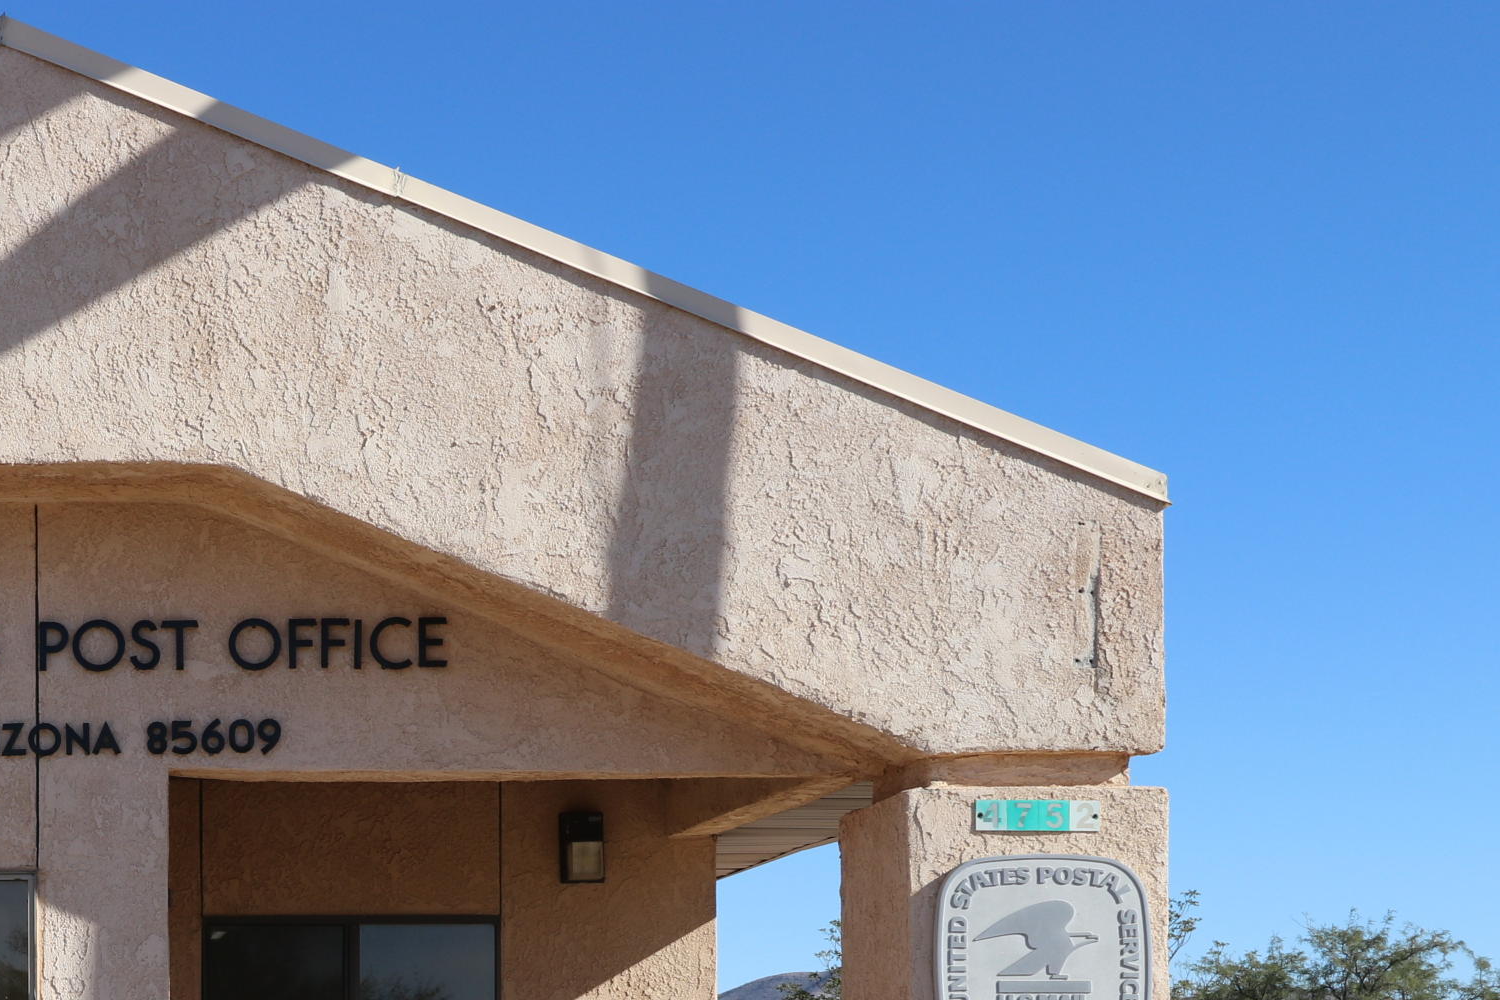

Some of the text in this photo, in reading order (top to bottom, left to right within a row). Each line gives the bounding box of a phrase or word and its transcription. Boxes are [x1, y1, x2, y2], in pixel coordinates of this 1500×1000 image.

[38, 618, 199, 672] POST
[228, 616, 449, 671] OFFICE
[146, 717, 282, 756] 85609
[950, 866, 1031, 910] STATES
[1035, 866, 1132, 905] POSTAL
